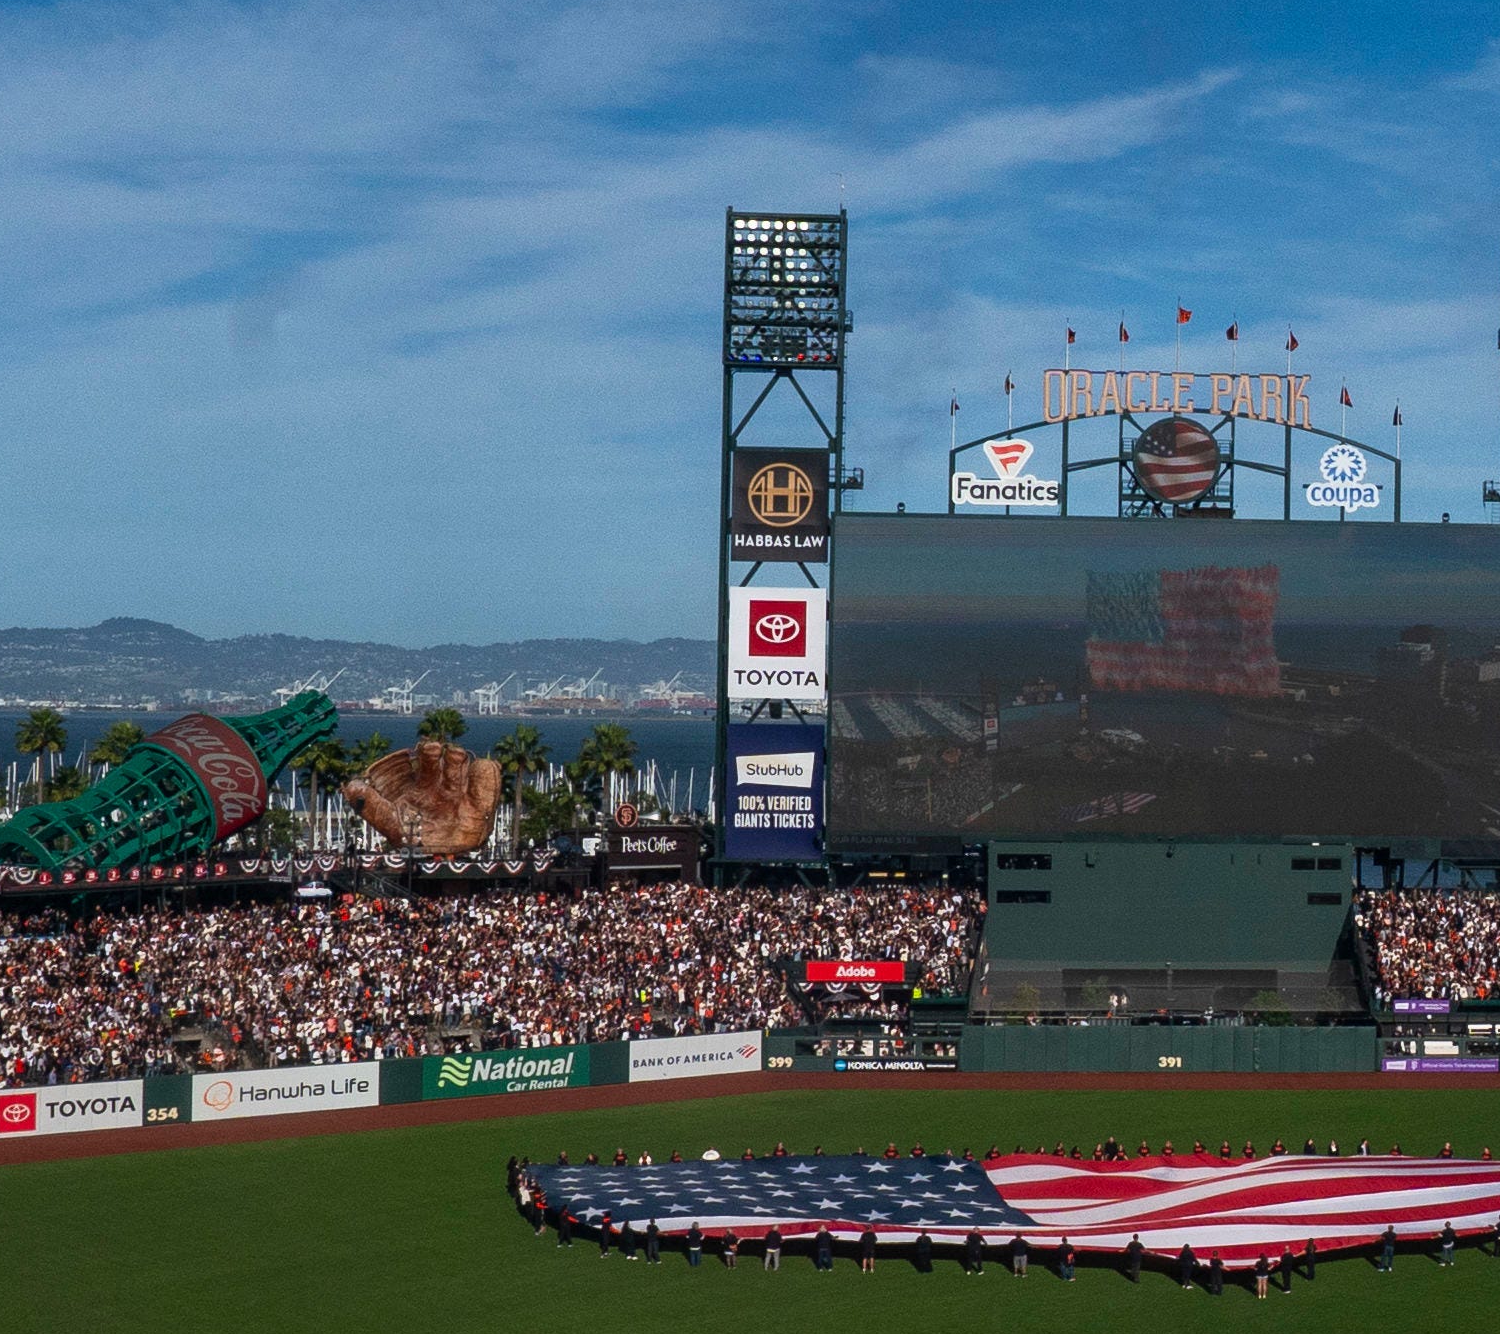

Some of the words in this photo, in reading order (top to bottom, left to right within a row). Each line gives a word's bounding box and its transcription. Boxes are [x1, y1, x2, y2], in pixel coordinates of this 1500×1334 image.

[1043, 369, 1194, 424] ORACLE
[1209, 373, 1312, 430] PARK
[956, 477, 1059, 501] Fanatics
[1311, 485, 1375, 507] coupa
[735, 534, 791, 548] HABBAS
[795, 535, 824, 548] LAW
[734, 670, 819, 686] TOYOTA
[746, 763, 804, 777] StubHub
[738, 795, 766, 811] 100%
[767, 795, 812, 811] VERIFIED
[734, 813, 771, 828] GIANTS
[772, 813, 815, 828] TICKETS
[648, 836, 677, 854] Coffee
[836, 965, 875, 979] Adobe
[472, 1052, 574, 1083] National
[633, 1058, 664, 1068] BANK
[667, 1056, 682, 1066] OF
[682, 1052, 734, 1065] AMERICA
[767, 1057, 793, 1068] 399
[847, 1061, 883, 1070] KONICA
[884, 1061, 925, 1070] MINOLTA
[1158, 1056, 1183, 1069] 391
[239, 1083, 326, 1103] Hanwha
[331, 1076, 370, 1095] Life
[506, 1080, 527, 1093] Car
[529, 1077, 569, 1090] Rental
[45, 1095, 136, 1119] TOYOTA
[147, 1107, 179, 1121] 354
